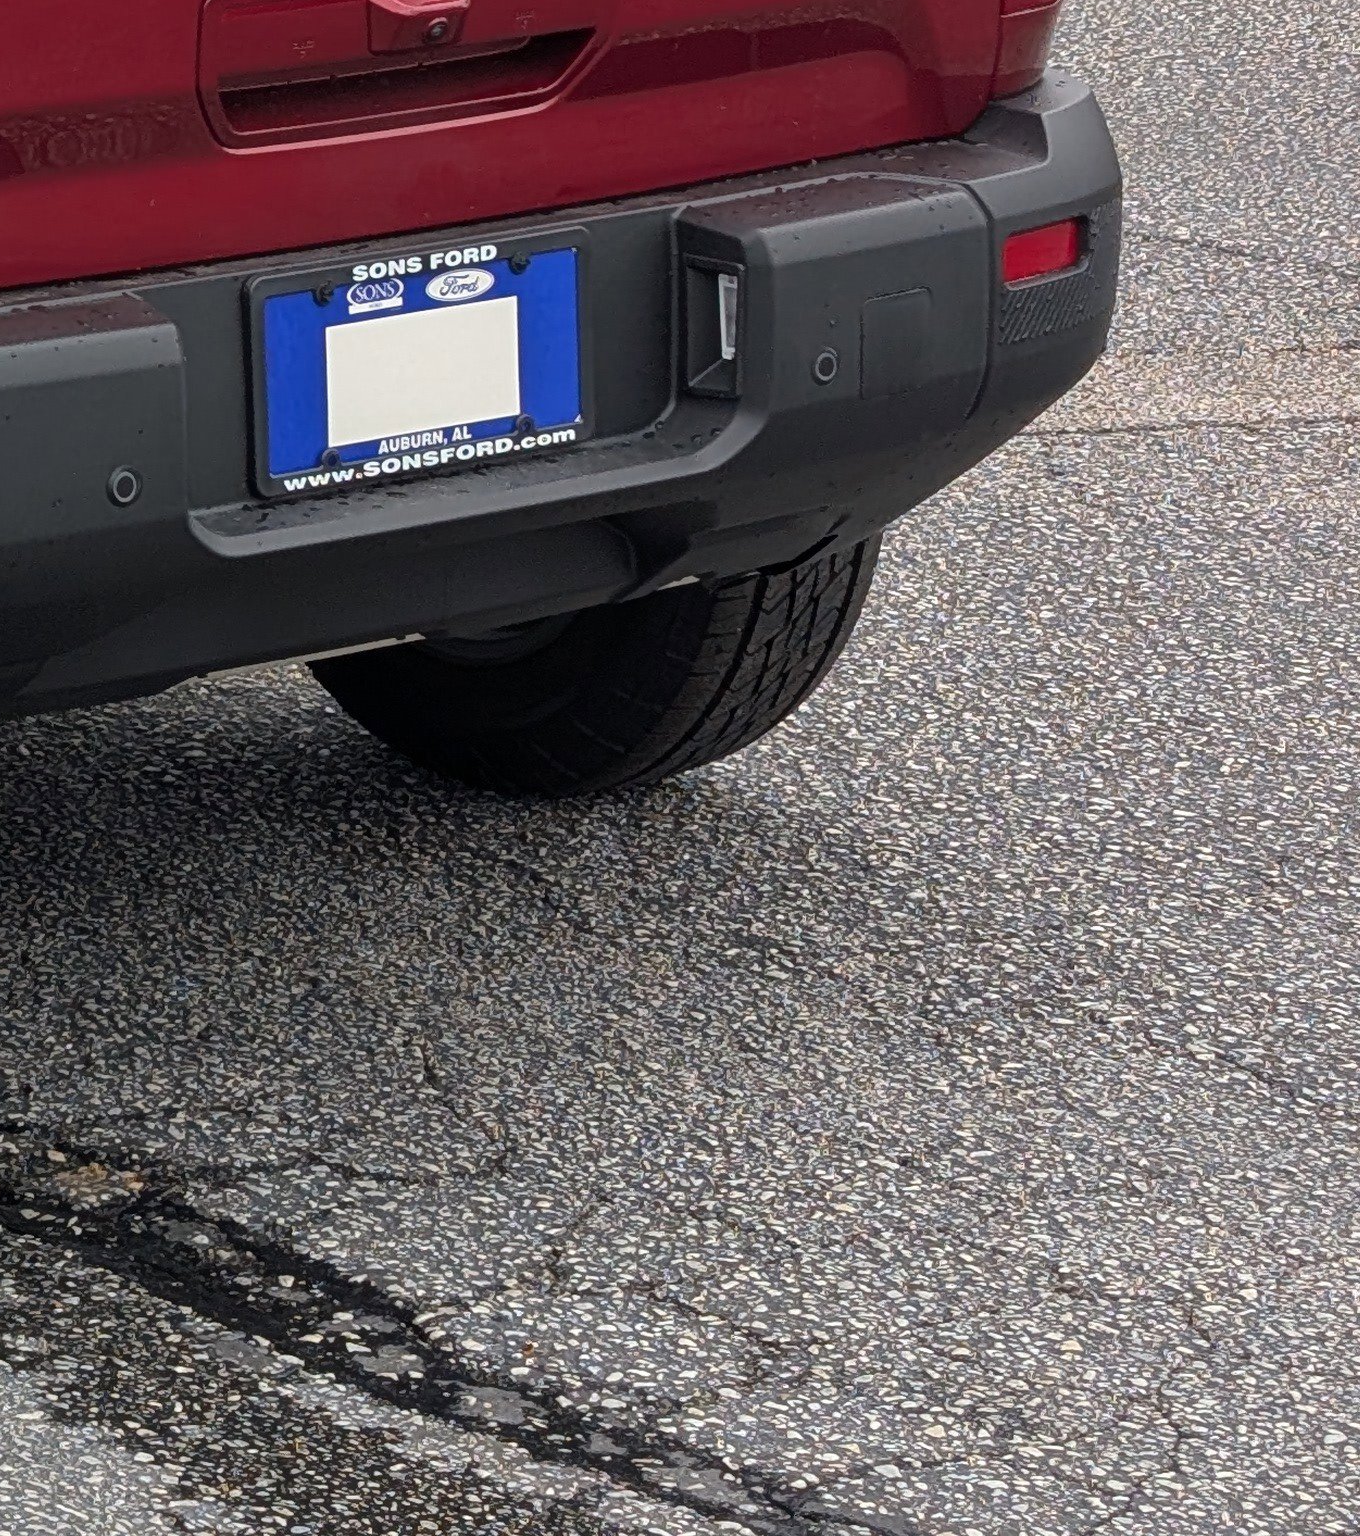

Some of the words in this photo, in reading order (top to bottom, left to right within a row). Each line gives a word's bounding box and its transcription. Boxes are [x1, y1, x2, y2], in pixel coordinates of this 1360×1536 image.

[352, 256, 422, 282] SONS
[430, 244, 498, 270] FORD
[355, 281, 395, 303] SONS
[438, 273, 481, 296] Ford
[377, 430, 448, 455] AUBURN,
[451, 426, 473, 442] AL
[283, 428, 577, 492] www.SONSFORD.com
